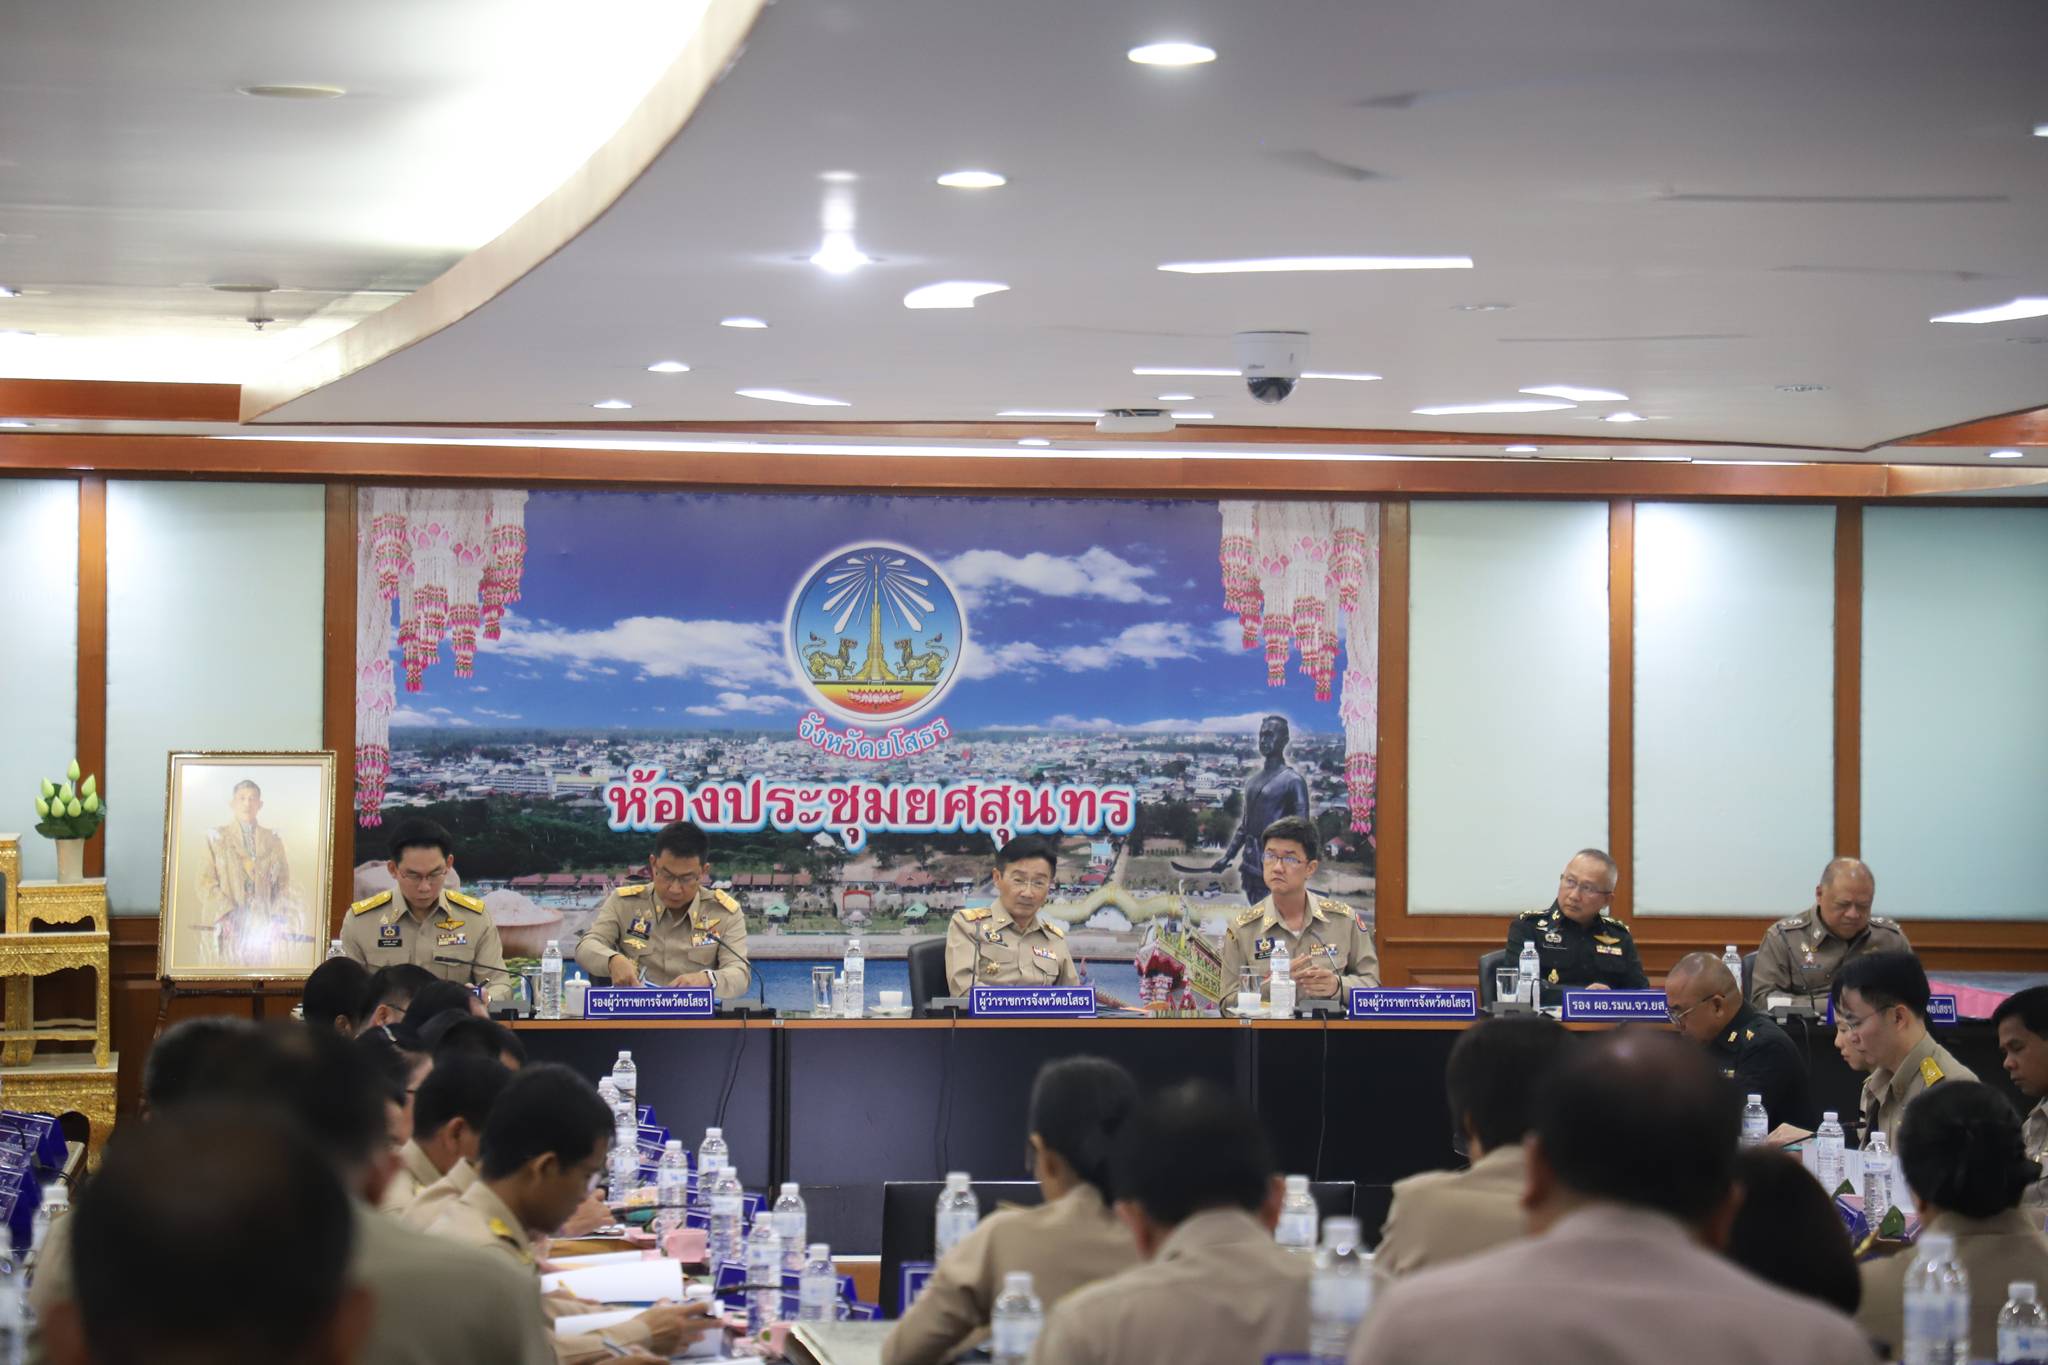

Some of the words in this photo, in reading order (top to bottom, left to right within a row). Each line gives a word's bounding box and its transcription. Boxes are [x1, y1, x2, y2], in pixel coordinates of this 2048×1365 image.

[801, 713, 949, 758] จังหวัดยโสธร
[608, 769, 1130, 845] ห้องประชุมยศสุนทร
[592, 993, 709, 1012] รองผู้ว่าราชการจังหวัดยโสธร
[979, 992, 1090, 1011] ผู้ว่าราชการจังหวัดยโสธร
[1358, 994, 1471, 1012] รองผู้ว่าราชการจังหวัดยโสธร
[1572, 1001, 1591, 1011] รอง
